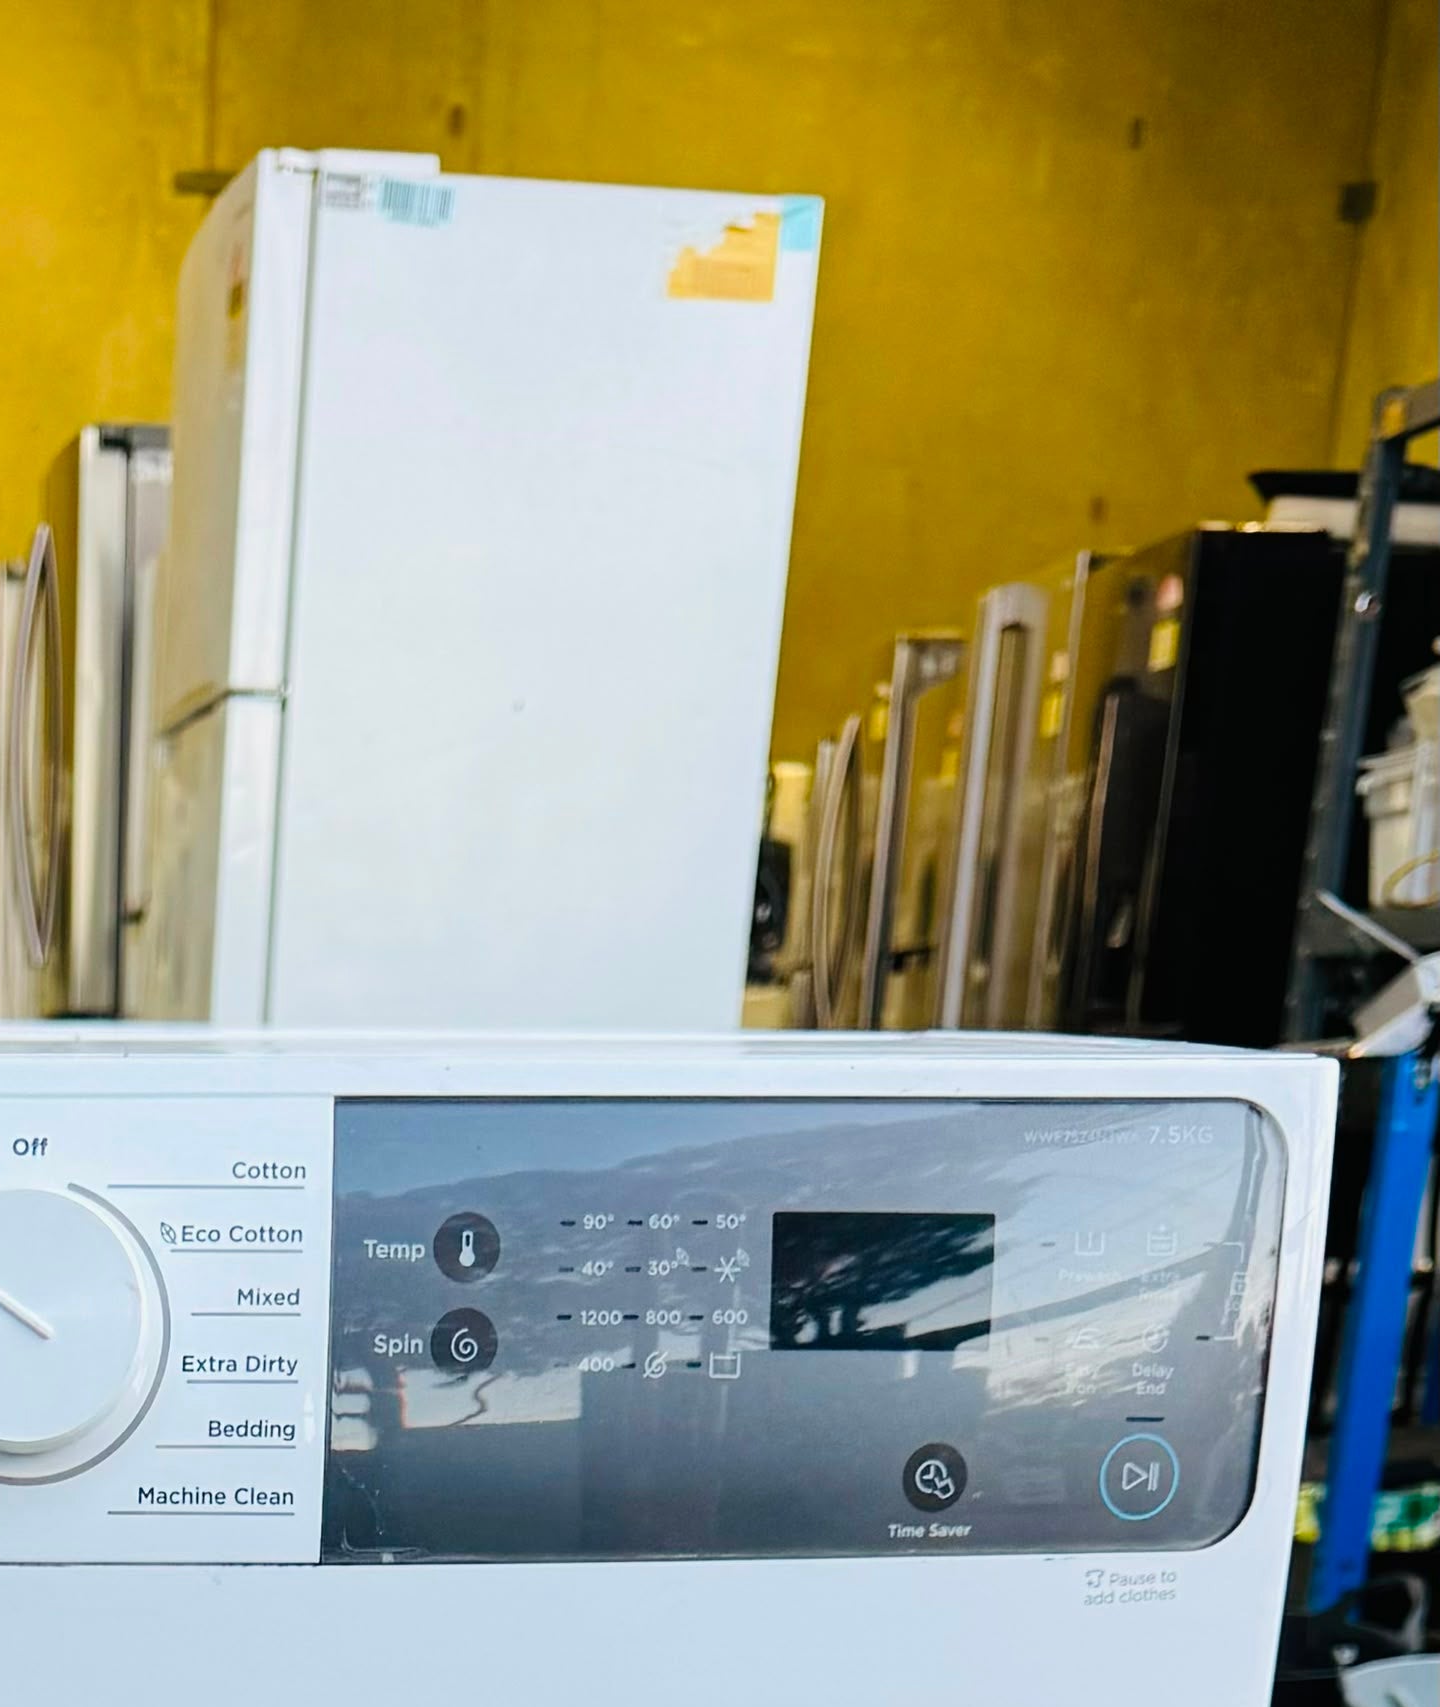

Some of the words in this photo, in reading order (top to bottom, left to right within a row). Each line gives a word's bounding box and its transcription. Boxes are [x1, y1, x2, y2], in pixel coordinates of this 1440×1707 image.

[1148, 1125, 1213, 1145] 7.5KG
[13, 1138, 48, 1156] Off
[232, 1161, 306, 1179] Cotton
[583, 1214, 614, 1229] 90°
[648, 1214, 680, 1229] 60°
[715, 1213, 746, 1229] 50°
[181, 1225, 221, 1243] Eco
[229, 1225, 303, 1243] Cotton
[363, 1239, 426, 1262] Temp
[581, 1260, 613, 1276] 40°
[647, 1260, 678, 1276] 30°
[237, 1288, 300, 1306] Mixed
[580, 1310, 622, 1325] 1200
[646, 1310, 681, 1325] 800
[712, 1310, 748, 1325] 600
[373, 1333, 424, 1357] Spin
[182, 1355, 237, 1373] Extra
[246, 1355, 298, 1376] Dirty
[578, 1357, 614, 1372] 400
[1132, 1362, 1174, 1380] Delay
[1137, 1380, 1166, 1396] End
[209, 1420, 296, 1441] Bedding
[138, 1487, 226, 1505] Machine
[234, 1487, 294, 1505] Clean
[888, 1524, 924, 1538] Time
[929, 1523, 972, 1538] Saver
[1109, 1572, 1156, 1587] Pause
[1161, 1571, 1177, 1584] to
[1083, 1591, 1114, 1606] add
[1119, 1588, 1176, 1604] clothes
